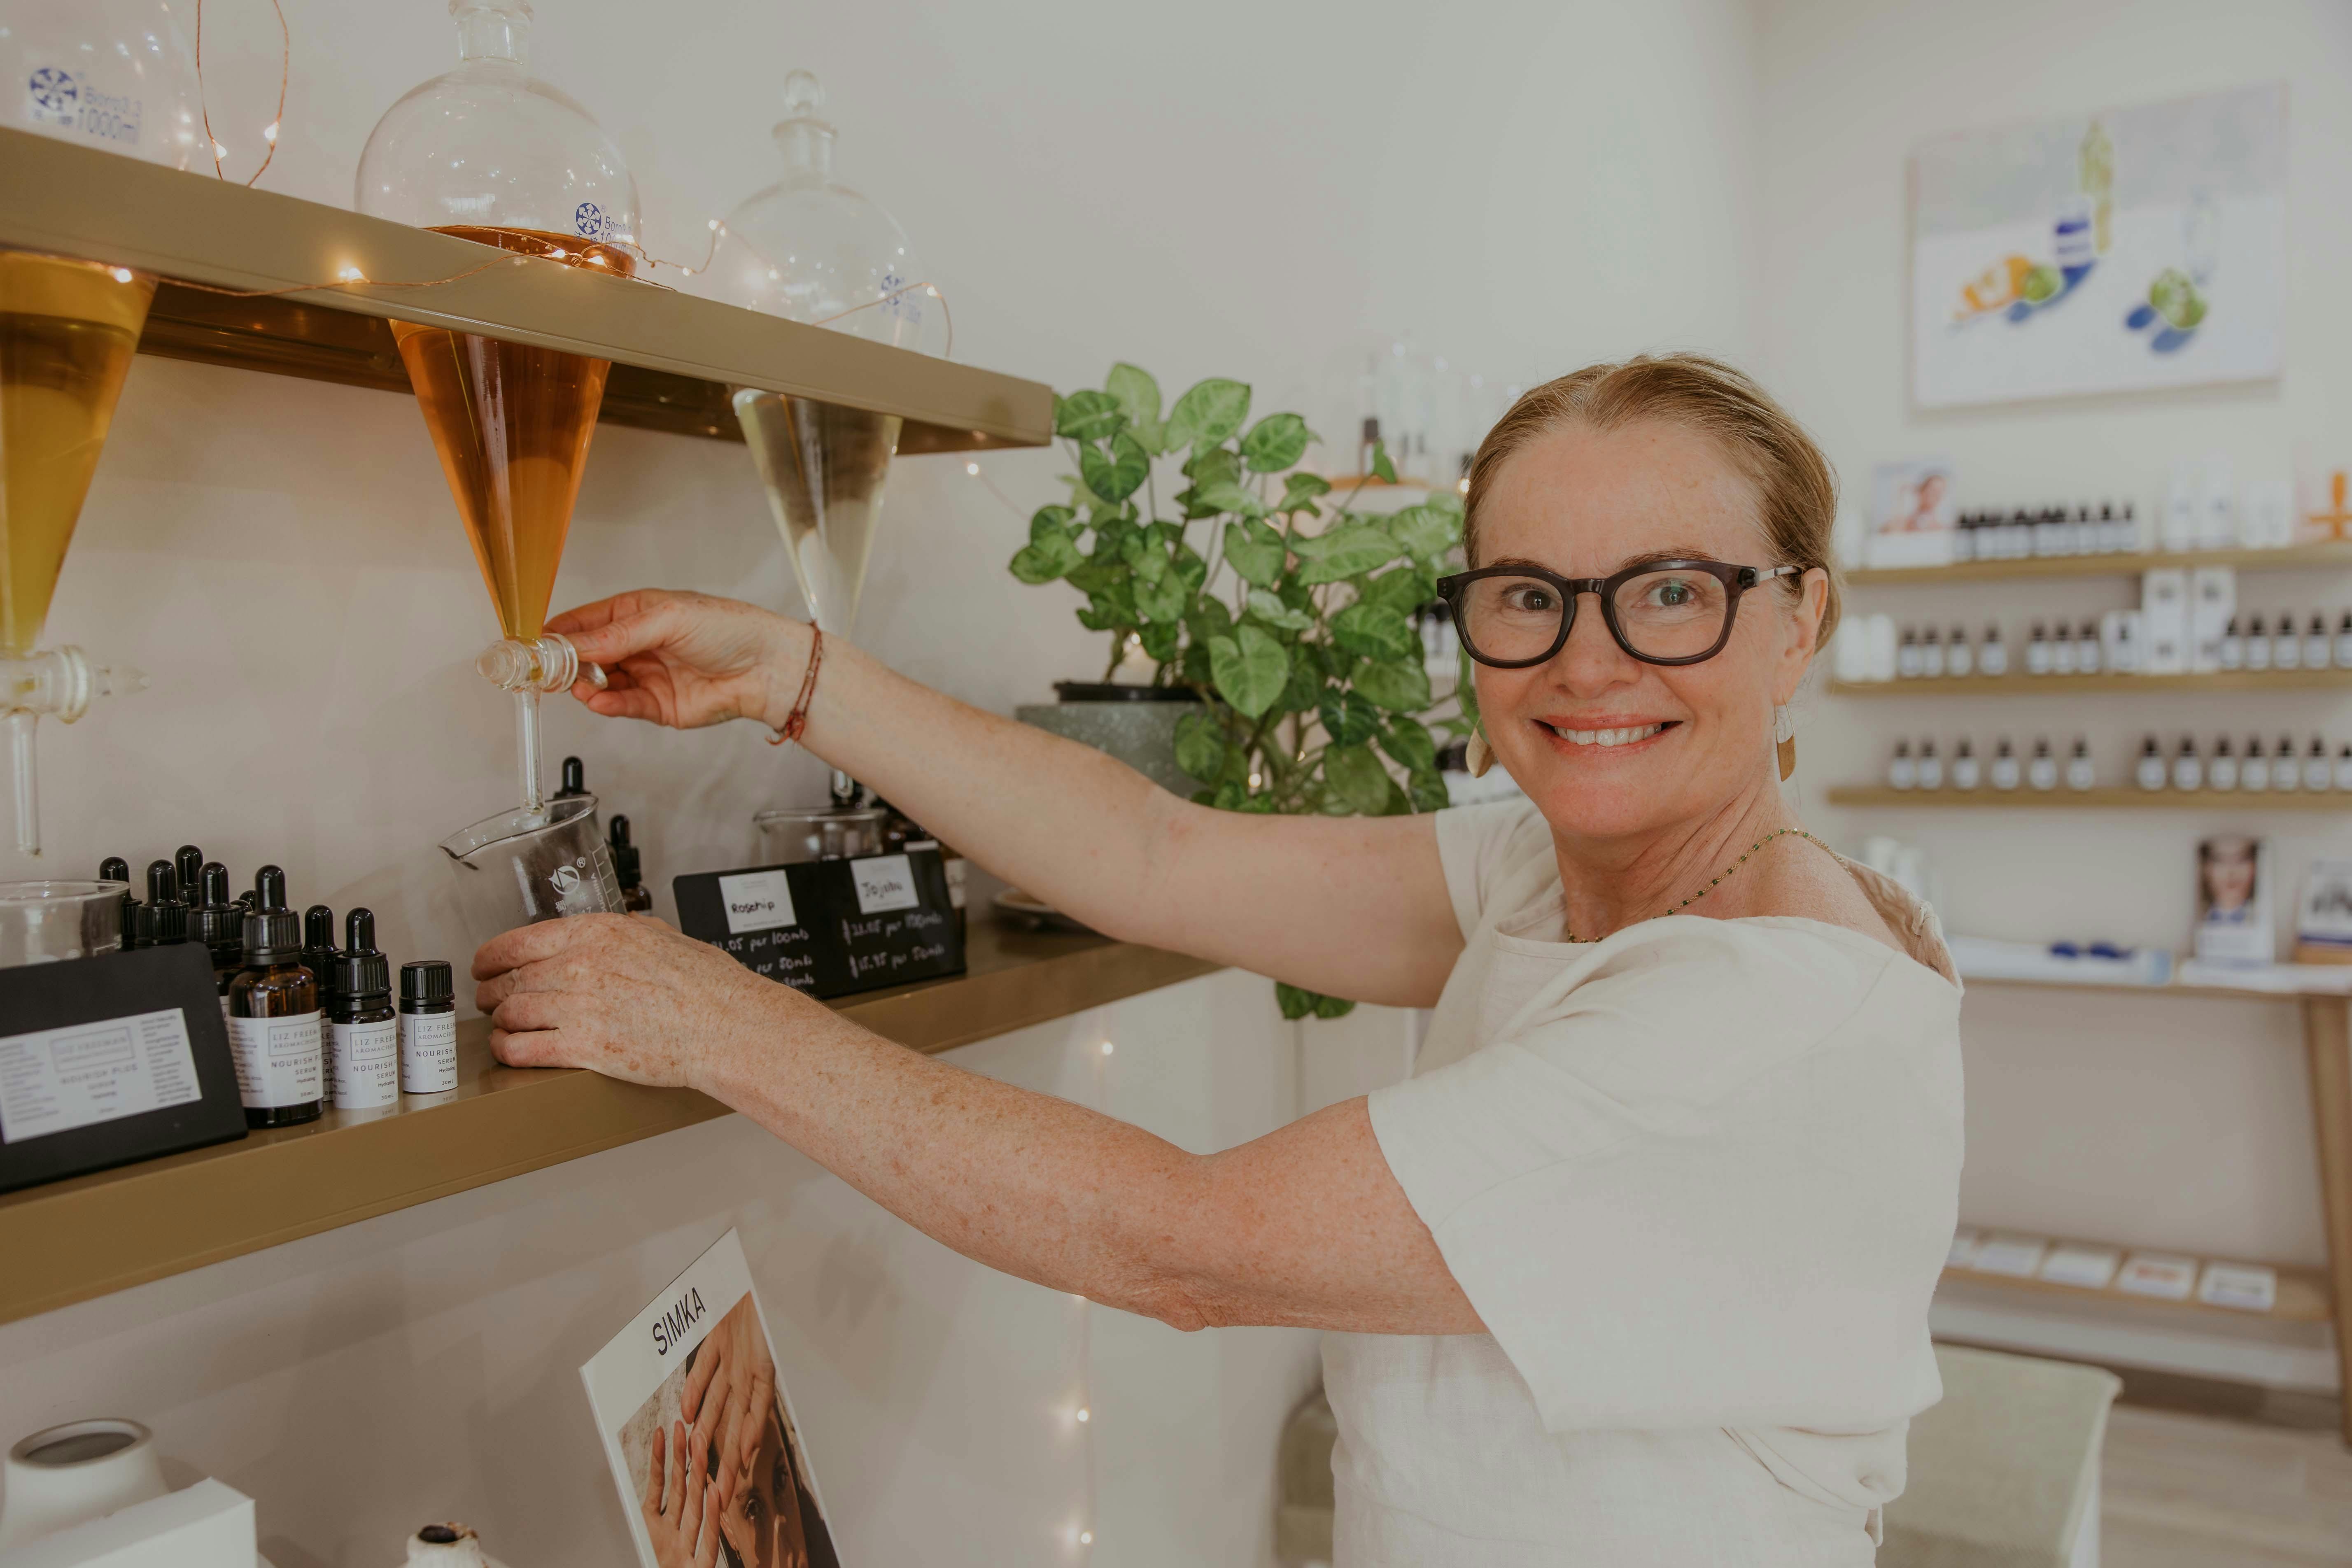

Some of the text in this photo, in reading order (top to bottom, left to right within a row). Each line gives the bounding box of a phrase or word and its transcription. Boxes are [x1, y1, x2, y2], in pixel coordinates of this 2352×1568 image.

[732, 898, 775, 913] Rosehip
[750, 937, 767, 952] per
[416, 1048, 453, 1057] NOURISH
[271, 1057, 312, 1067] NOURISH
[353, 1062, 393, 1072] NOURISH
[295, 1067, 316, 1075] SERUM
[376, 1070, 395, 1079] SERUM
[652, 1287, 707, 1356] SIMKA
